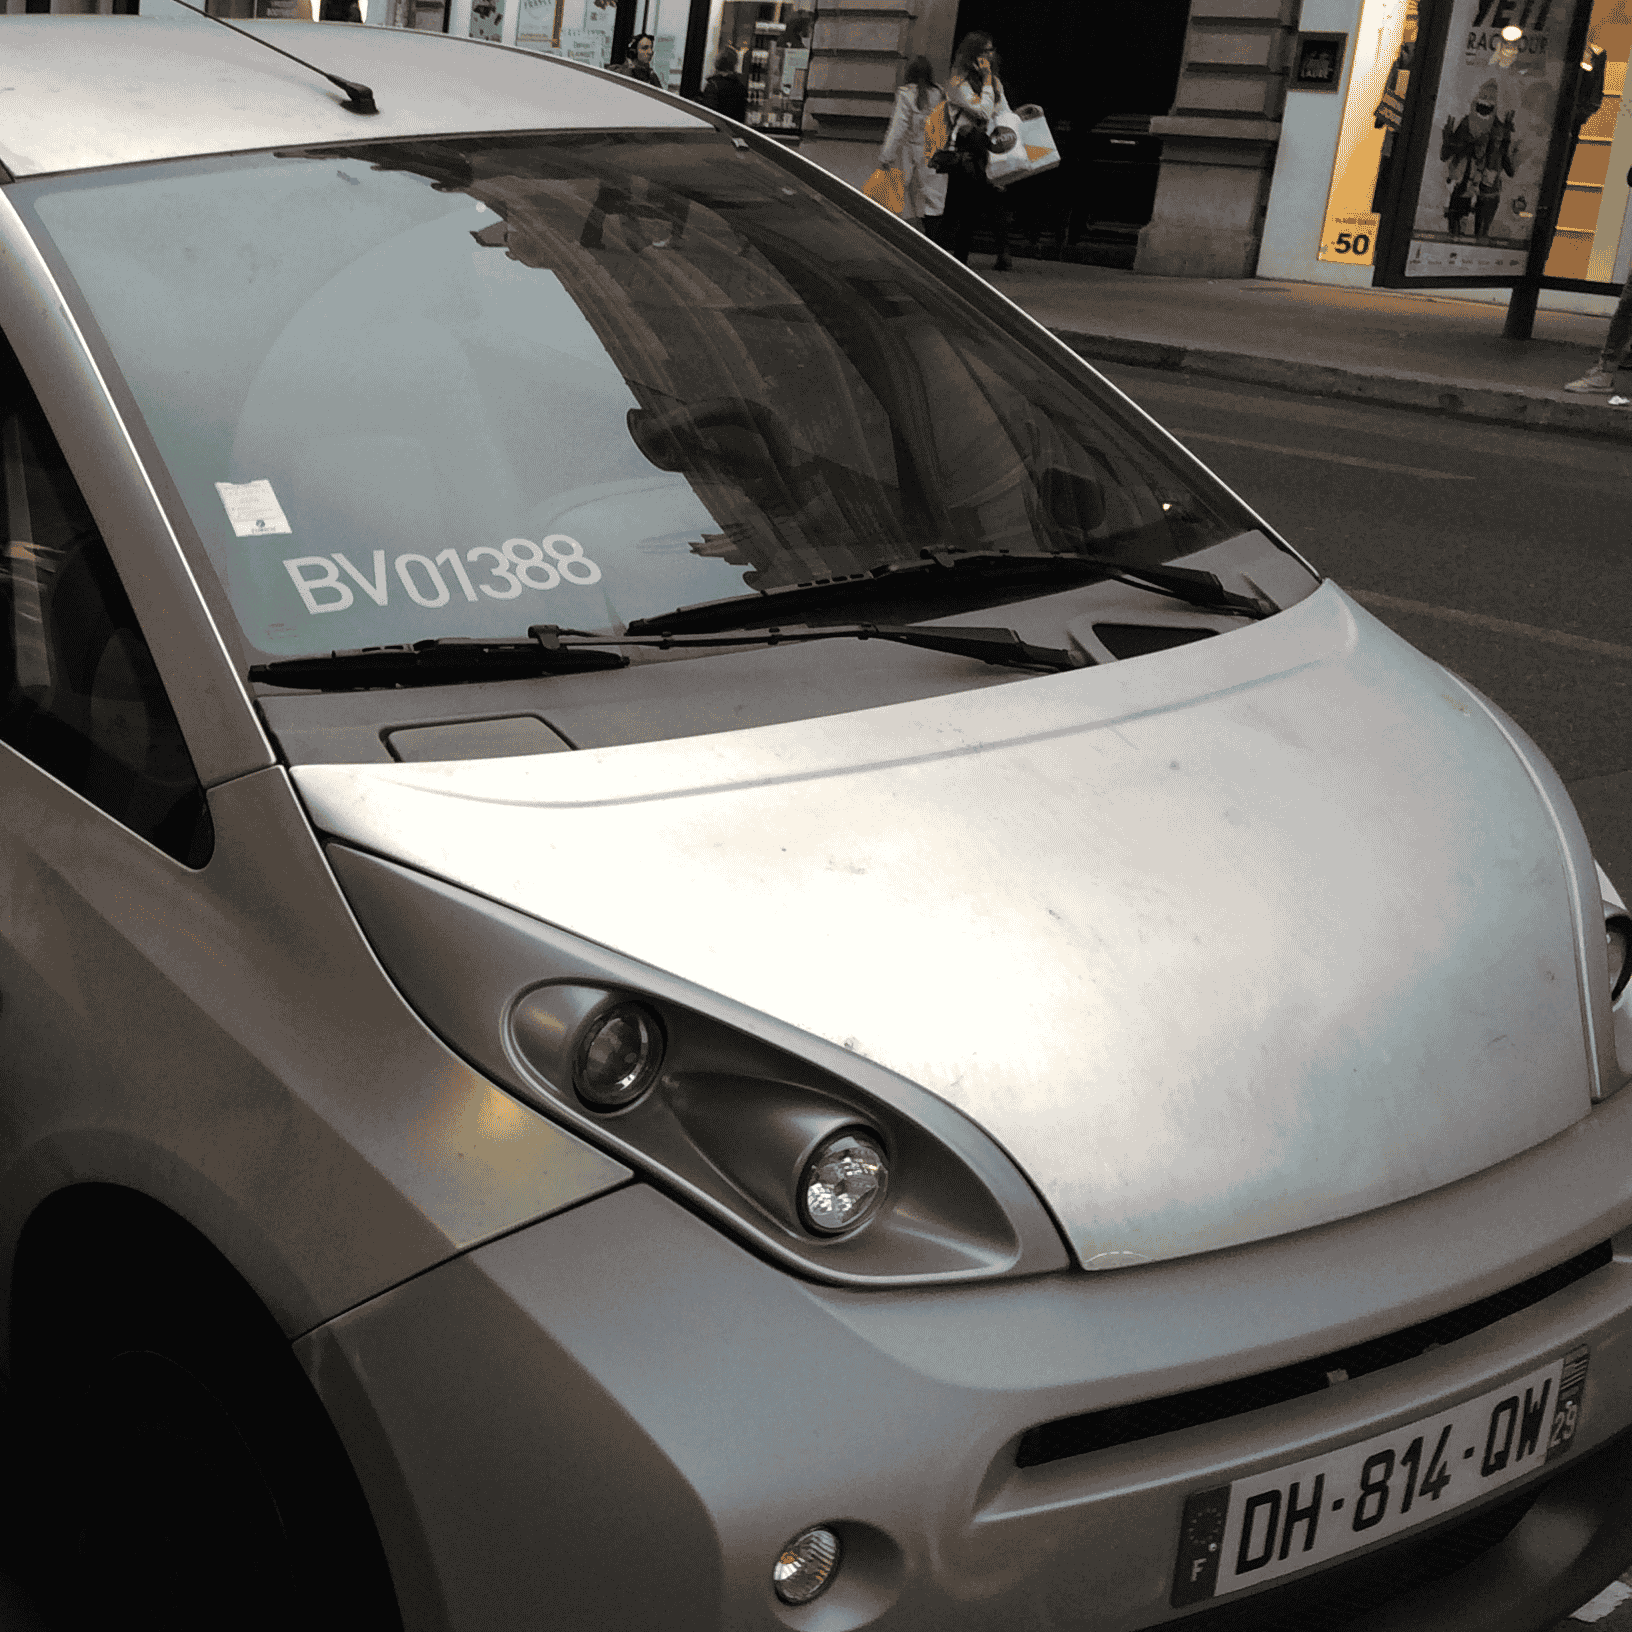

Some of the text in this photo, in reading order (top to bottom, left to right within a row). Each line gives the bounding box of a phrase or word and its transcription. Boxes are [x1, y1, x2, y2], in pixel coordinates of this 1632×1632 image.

[1334, 233, 1370, 255] 50
[282, 534, 602, 615] BV01388
[1189, 1557, 1208, 1583] F
